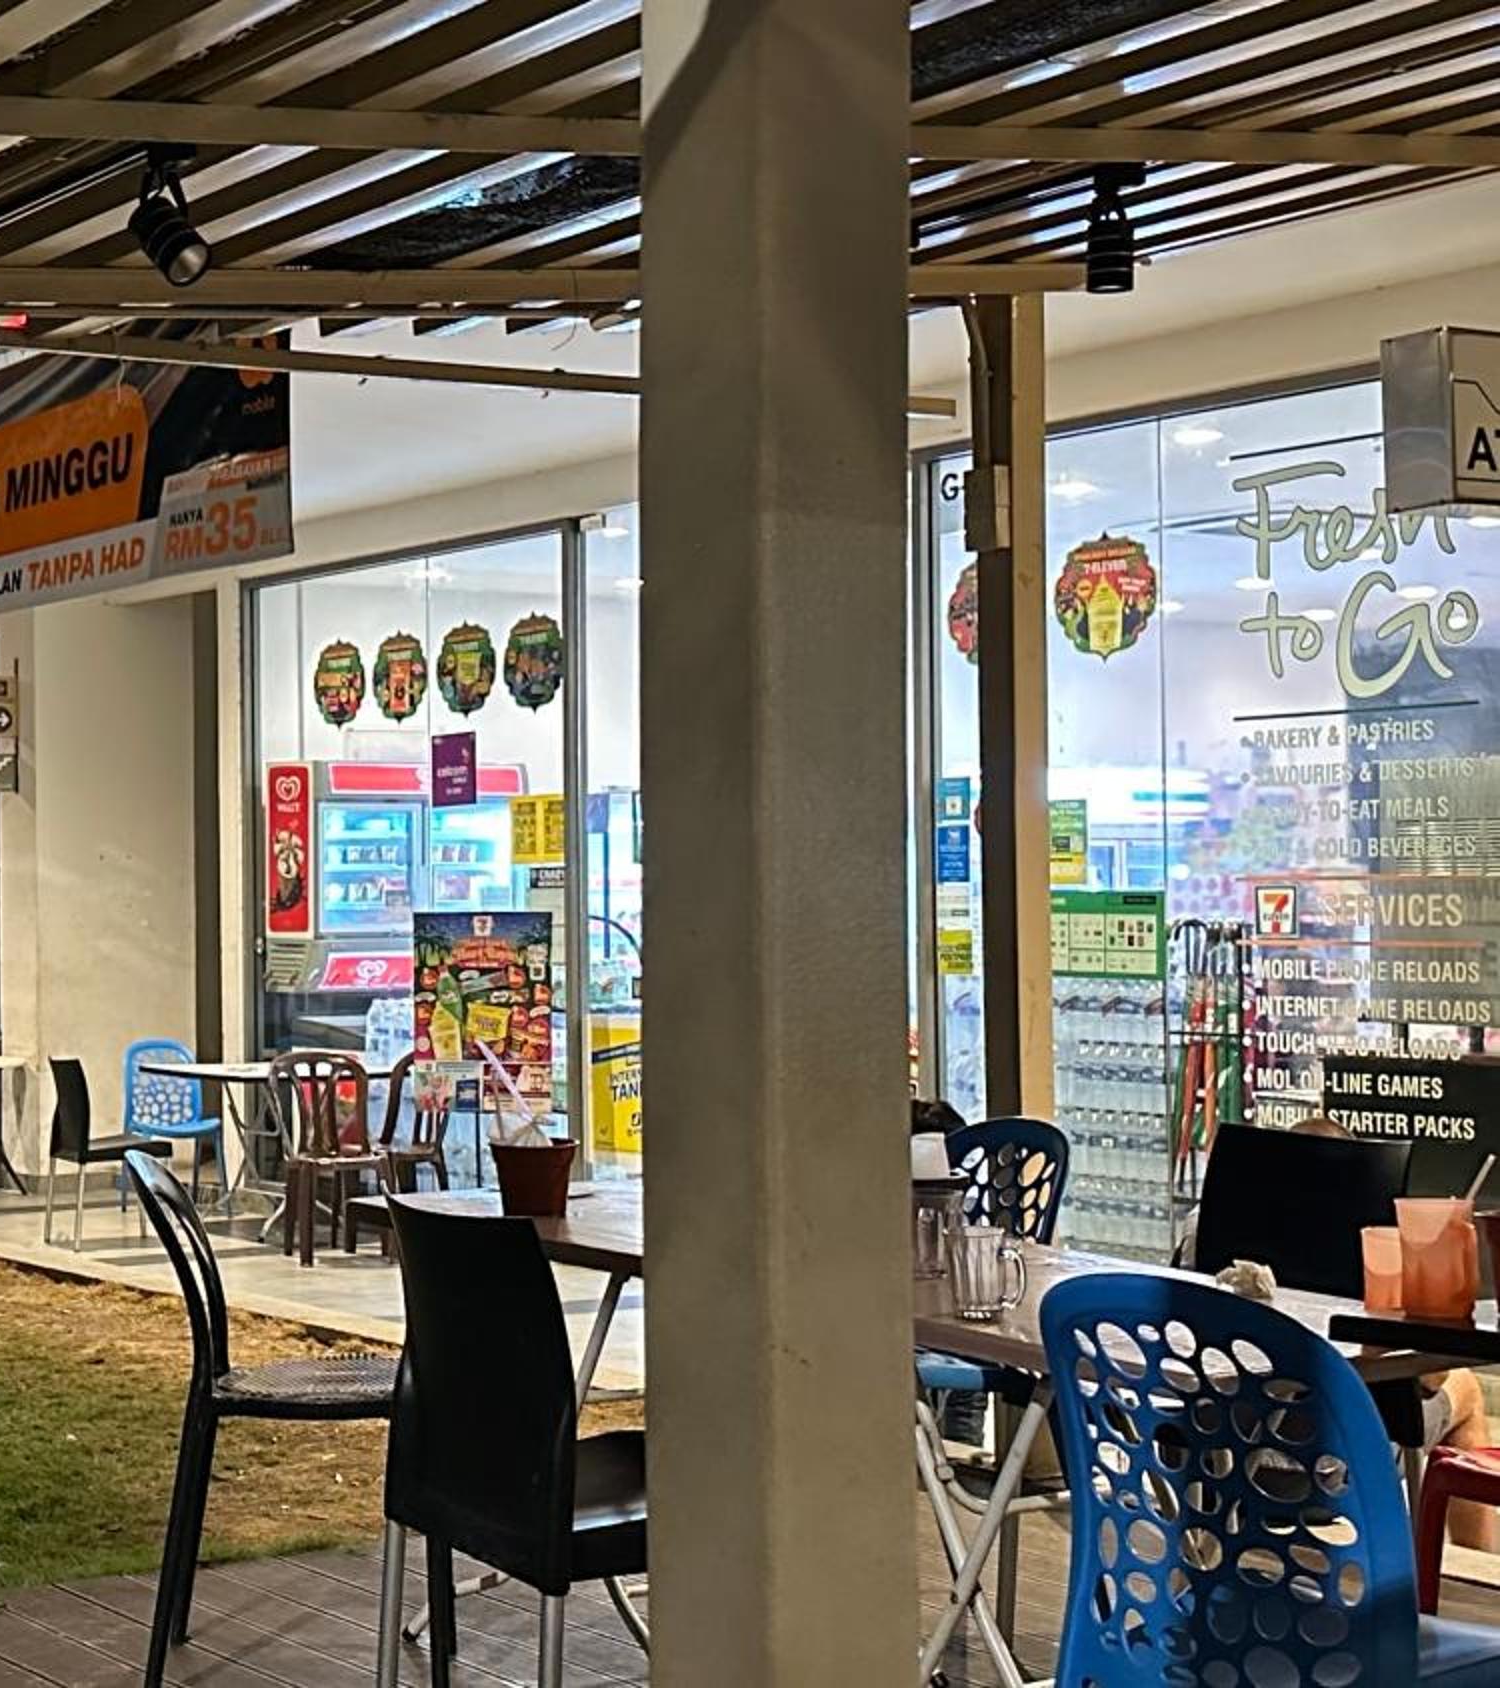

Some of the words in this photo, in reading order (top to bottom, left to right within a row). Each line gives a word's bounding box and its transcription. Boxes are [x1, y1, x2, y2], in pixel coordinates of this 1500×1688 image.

[1467, 426, 1500, 471] A
[4, 432, 134, 513] MINGGU
[28, 551, 95, 590] TANPA
[100, 536, 145, 574] HAD
[1239, 591, 1323, 679] to
[1335, 570, 1479, 698] Go
[1253, 726, 1323, 749] BAKERY
[1327, 725, 1341, 746] &
[1348, 719, 1435, 744] PASTRIES
[1359, 762, 1373, 783] &
[1379, 758, 1475, 780] DESSERTS
[1385, 795, 1450, 818] MEALS
[1316, 837, 1362, 858] COLD
[1368, 834, 1477, 858] BEVERAGES
[1318, 894, 1463, 927] SERVICES
[1255, 958, 1320, 980] MOBILE
[1326, 960, 1388, 982] PHONE
[1392, 961, 1480, 983] RELOADS
[1256, 996, 1344, 1017] INTERNET
[1403, 1001, 1491, 1023] RELOADS
[1257, 1031, 1316, 1053] TOUCH
[1375, 1038, 1461, 1061] RELOADS
[1257, 1067, 1294, 1089] MOL
[1300, 1069, 1373, 1095] ON-LINE
[1377, 1073, 1443, 1099] GAMES
[1328, 1109, 1409, 1136] STARTER
[1414, 1115, 1475, 1140] PACKS
